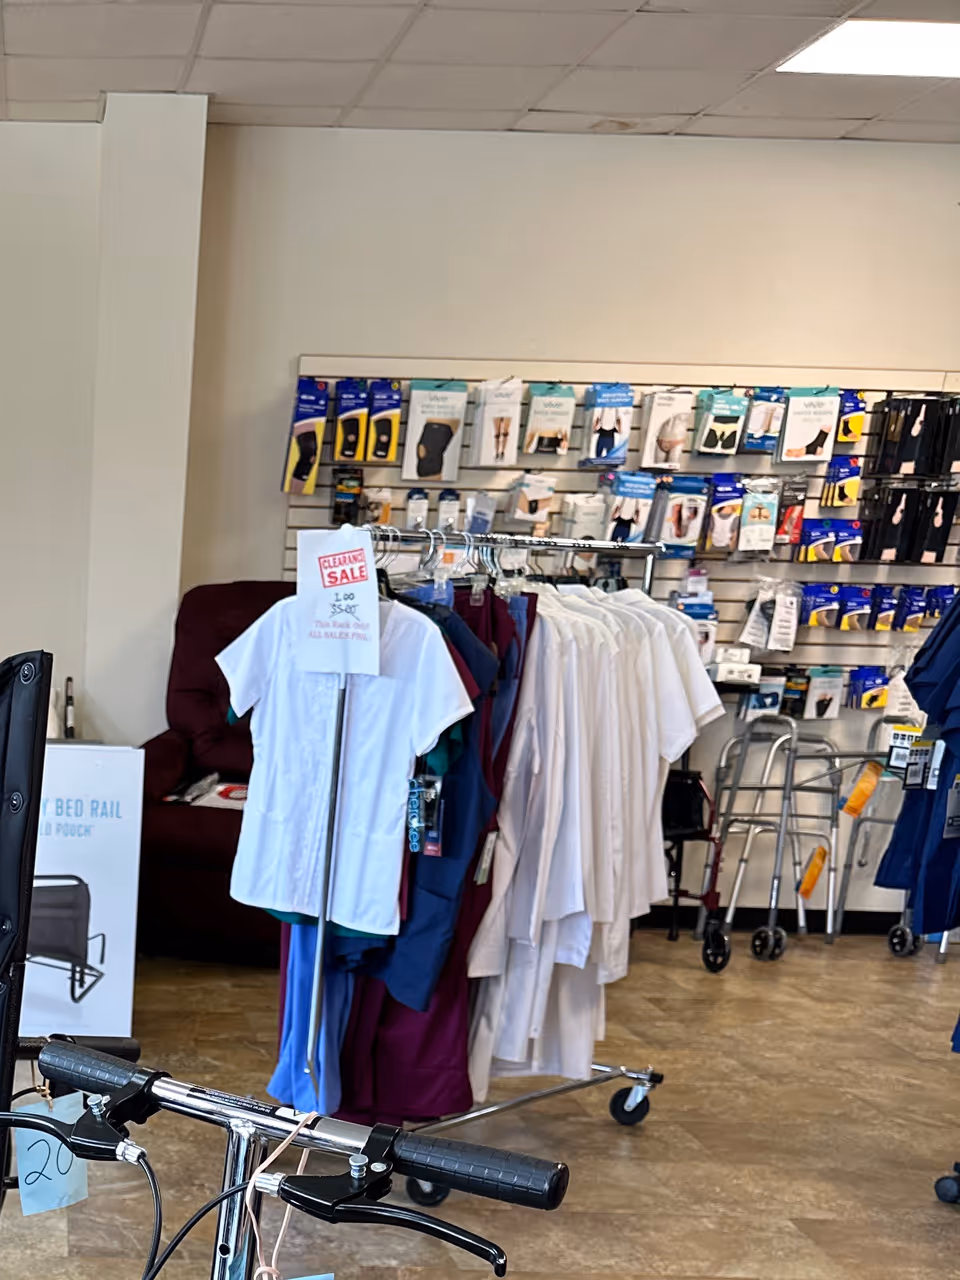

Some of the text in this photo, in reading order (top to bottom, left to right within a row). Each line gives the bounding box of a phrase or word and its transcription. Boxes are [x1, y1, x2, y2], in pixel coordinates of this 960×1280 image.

[327, 565, 367, 585] SALE
[55, 798, 84, 817] BED
[90, 799, 122, 819] RAIL
[408, 778, 425, 853] cherokee
[56, 823, 91, 838] POUCH
